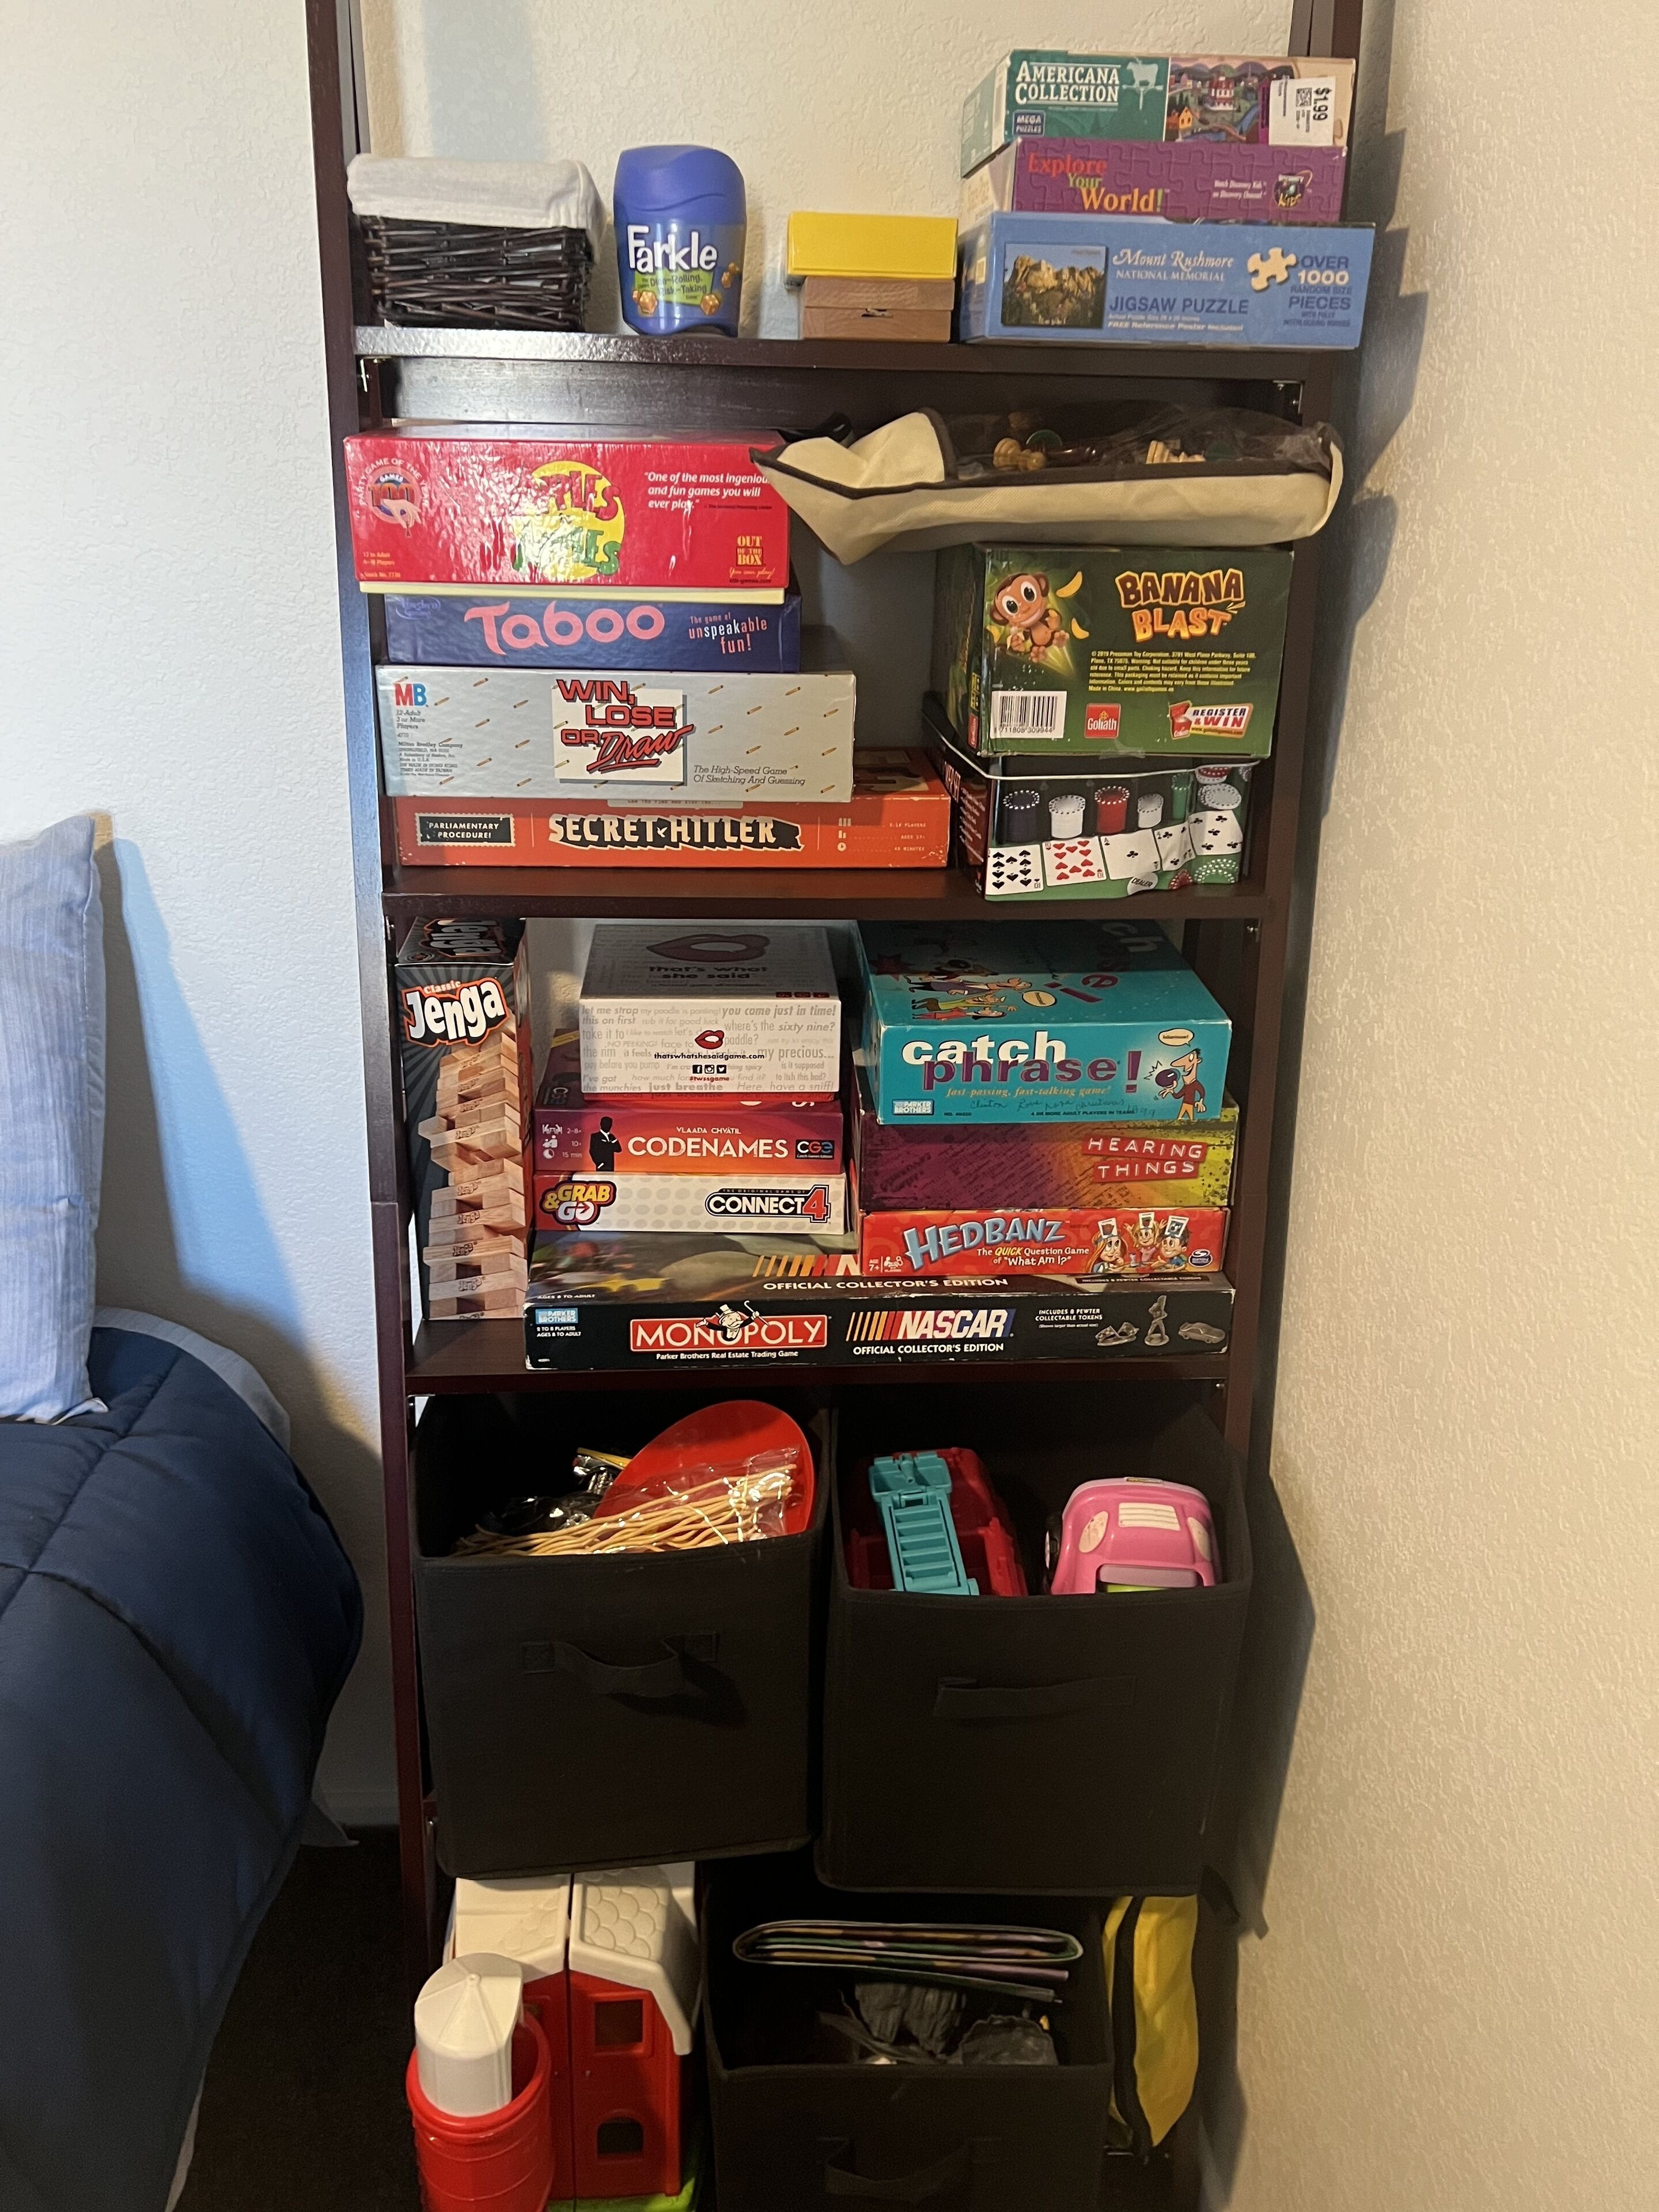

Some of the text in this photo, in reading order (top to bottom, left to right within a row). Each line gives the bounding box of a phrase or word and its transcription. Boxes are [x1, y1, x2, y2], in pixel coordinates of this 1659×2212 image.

[1016, 60, 1119, 84] AMERICANA
[1015, 83, 1119, 104] COLLECTION
[1017, 115, 1041, 124] MEGA
[1016, 125, 1041, 133] PUZZLES
[1028, 152, 1107, 179] Explore
[1068, 173, 1103, 188] Your
[1080, 187, 1164, 213] World!
[627, 225, 718, 273] Farkle
[1112, 248, 1234, 272] Mount Rushmore
[1301, 255, 1349, 268] OVER
[1116, 270, 1224, 282] NATIONAL MEMORIAL
[1298, 269, 1349, 286] 1000
[1109, 296, 1249, 315] JIGSAW PUZZLE
[1289, 296, 1351, 310] PIECES
[357, 457, 429, 507] PARTY GAME OF THE YEAR
[380, 474, 403, 482] GAMES
[644, 471, 771, 486] "One of the most ingeniou
[648, 485, 760, 499] and fun games you will
[648, 500, 669, 509] ever
[737, 536, 762, 547] OUT
[737, 555, 763, 565] BOX
[1115, 569, 1244, 608] BANANA
[691, 612, 730, 624] The game of
[1132, 607, 1231, 642] BLAST
[464, 600, 665, 656] Taboo
[688, 616, 767, 640] unspeakable
[721, 634, 751, 654] fun!
[393, 683, 427, 706] MB
[556, 679, 635, 705] WIN,
[585, 704, 675, 726] LOSE
[1193, 708, 1247, 716] REGISTER
[1088, 718, 1116, 730] Goliath
[1204, 717, 1243, 727] WIN
[561, 724, 694, 771] OR Draw
[694, 765, 709, 773] The
[711, 765, 760, 775] High-Speed
[694, 774, 704, 782] Of
[706, 775, 745, 785] Sketching
[768, 777, 805, 786] Guessing
[549, 813, 776, 843] SECRET HITLER
[1131, 878, 1153, 887] DEALER
[424, 980, 461, 994] Classic
[406, 982, 505, 1040] Jenga
[722, 1007, 741, 1018] you
[774, 1005, 793, 1018] just
[797, 1005, 806, 1016] in
[809, 1005, 836, 1016] time!
[724, 1020, 835, 1033] where's the sixty nine?
[725, 1035, 759, 1047] paddle?
[902, 1031, 1066, 1065] catch
[654, 1052, 765, 1060] thatswhatshesaidgame.com
[757, 1046, 834, 1061] my precious...
[649, 1082, 723, 1092] just breathe
[737, 1082, 766, 1091] Here,
[809, 1082, 834, 1091] sniff!
[711, 1126, 741, 1134] CHVÁTIL
[627, 1137, 788, 1158] CODENAMES
[797, 1141, 834, 1153] CGE
[1088, 1138, 1202, 1158] HEARING
[1098, 1161, 1194, 1178] THINGS
[558, 1185, 611, 1202] GRAB
[544, 1193, 594, 1221] & GO
[709, 1188, 827, 1219] CONNECT 4
[903, 1218, 1066, 1270] HEDBANZ
[995, 1247, 1022, 1256] QUICK
[1024, 1248, 1062, 1257] Question
[1004, 1257, 1036, 1266] "What
[1037, 1256, 1054, 1266] Am
[763, 1278, 1008, 1290] OFFICIAL COLLECTOR'S EDITION
[897, 1309, 1008, 1340] NASCAR
[853, 1343, 1004, 1355] OFFICIAL COLLECTOR'S EDITION
